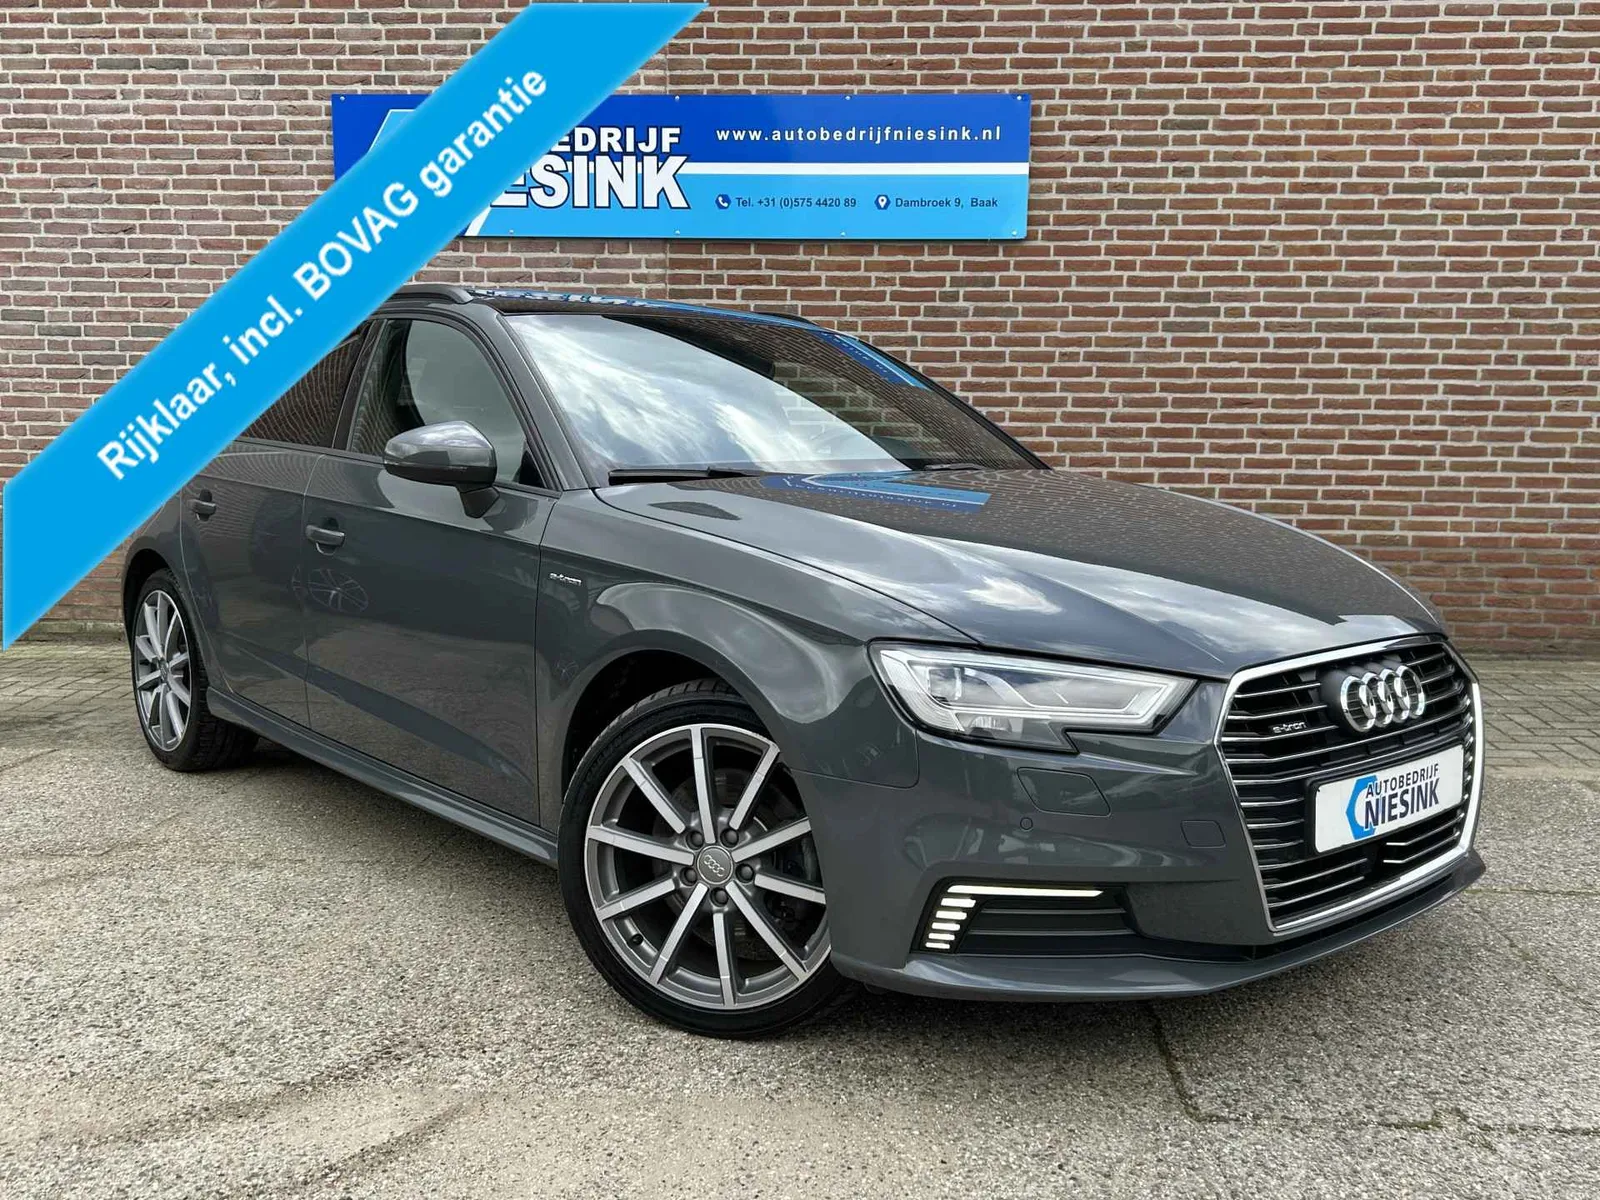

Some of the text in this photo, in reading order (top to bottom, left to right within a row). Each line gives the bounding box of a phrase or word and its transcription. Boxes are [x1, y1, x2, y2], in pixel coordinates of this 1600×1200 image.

[716, 126, 1001, 145] www.autobedrijfniesink.nl
[735, 196, 857, 210] Tel. +31 (0)575 4420 89
[895, 196, 998, 210] Dambroek 9, Baak
[1272, 721, 1307, 734] e-tron
[1365, 763, 1439, 799] AUTOBEDRIJF
[1364, 777, 1440, 830] NIESINK
